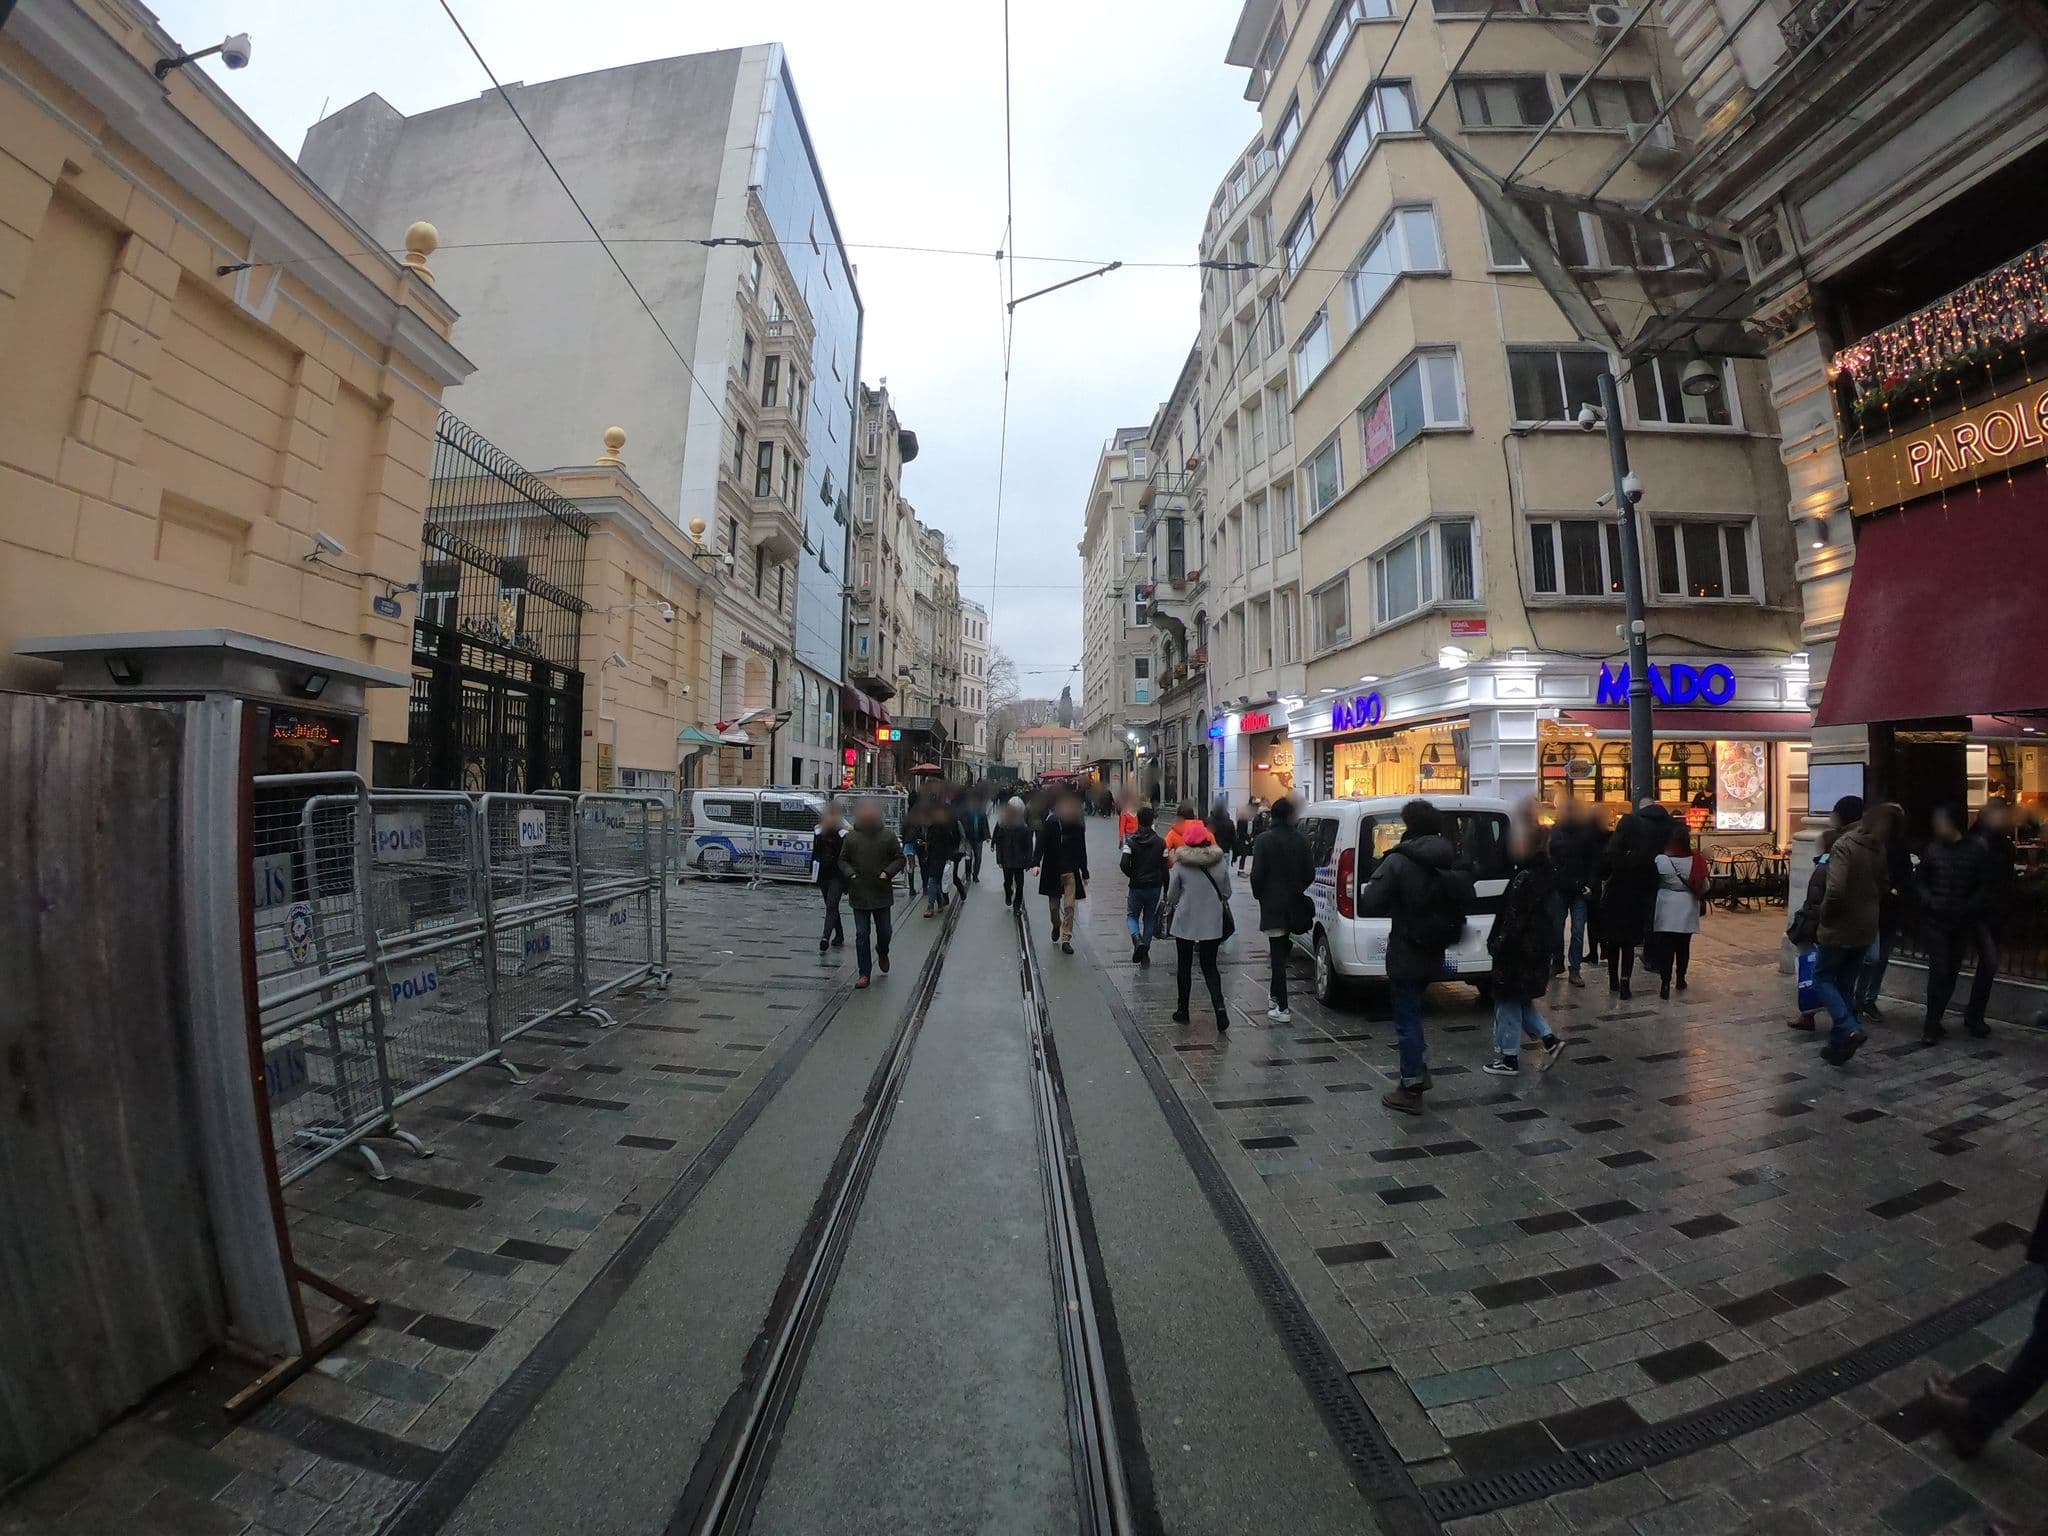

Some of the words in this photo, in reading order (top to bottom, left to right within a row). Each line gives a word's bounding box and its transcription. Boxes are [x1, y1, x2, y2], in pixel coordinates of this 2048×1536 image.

[1597, 662, 1737, 706] MADO
[1332, 692, 1384, 731] MADO
[378, 825, 425, 851] POLİS
[521, 819, 545, 842] POLİS
[393, 972, 437, 1002] POLİS
